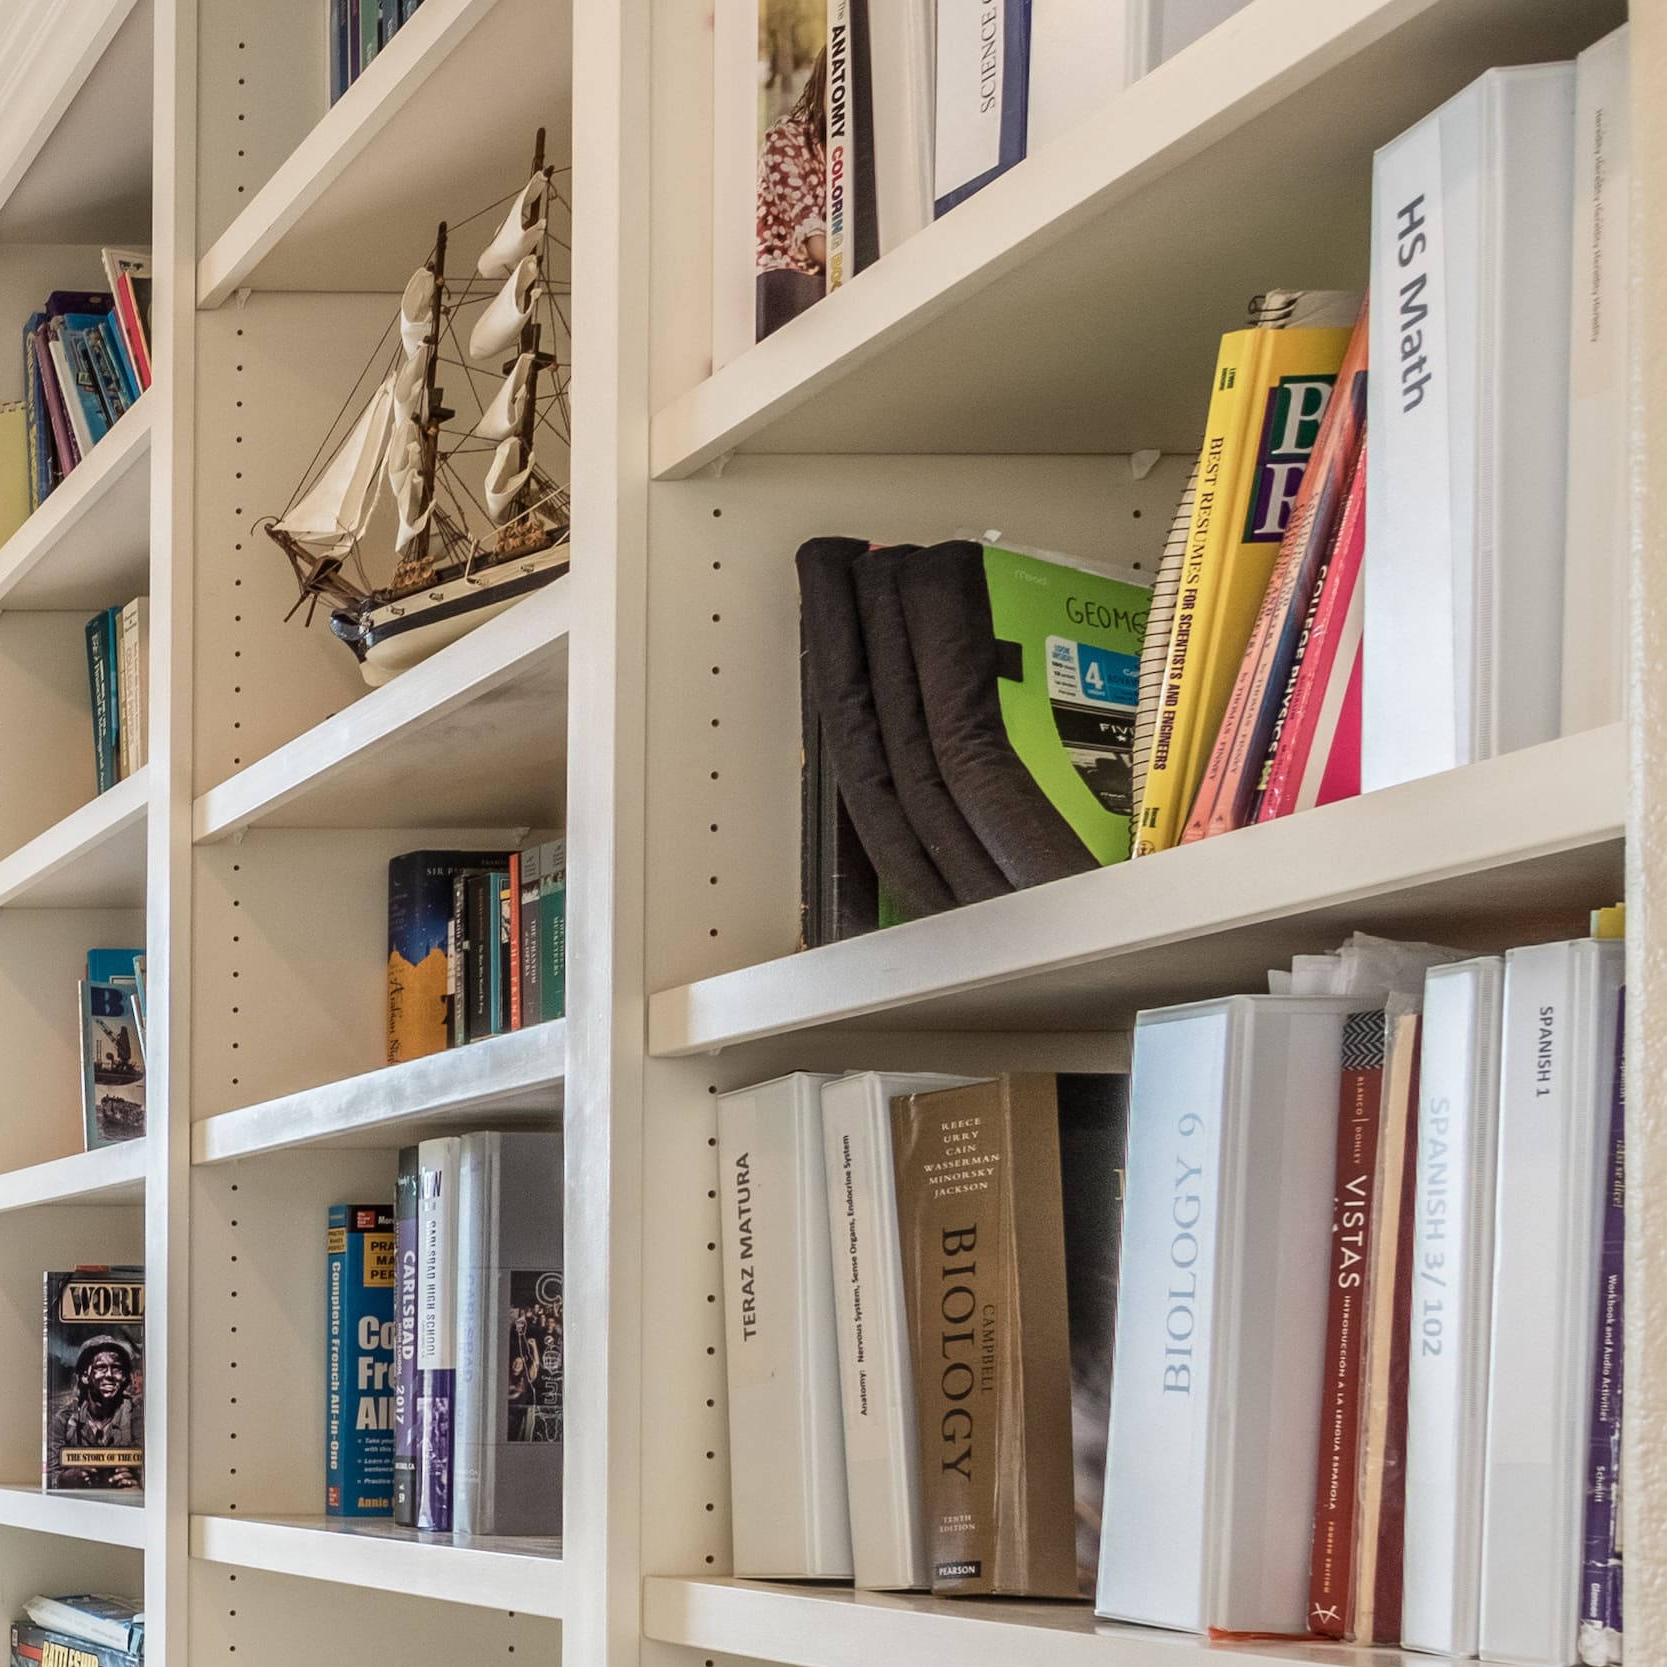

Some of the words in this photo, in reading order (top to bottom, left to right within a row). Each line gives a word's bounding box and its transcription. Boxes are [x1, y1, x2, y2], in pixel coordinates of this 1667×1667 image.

[831, 24, 846, 138] ANATOMY
[980, 7, 997, 114] SCIENCE
[830, 146, 844, 250] COLORING
[1397, 193, 1426, 268] HS
[1400, 272, 1432, 414] Math
[1204, 436, 1225, 488] BEST
[1187, 491, 1215, 587] RESUMES
[1178, 587, 1198, 612] FOR
[1167, 613, 1194, 679] SCIENTISTS
[1084, 661, 1104, 690] 4
[1162, 681, 1183, 707] AND
[1152, 709, 1178, 771] ENGINEERS
[1536, 1005, 1555, 1083] SPANISH
[1536, 1086, 1551, 1098] 1
[941, 1117, 982, 1131] REECE
[943, 1130, 980, 1144] URRY
[1178, 1112, 1205, 1136] 9
[840, 1134, 853, 1168] System
[923, 1153, 1000, 1172] WASSERMAN
[945, 1144, 977, 1156] CAIN
[1426, 1095, 1450, 1242] SPANISH
[842, 1170, 857, 1216] Endocrine
[929, 1167, 994, 1185] MINORSKY
[934, 1182, 988, 1199] JACKSON
[735, 1151, 756, 1261] MATURA
[425, 1220, 437, 1279] CARLSBAD
[845, 1217, 859, 1251] Organs,
[1338, 1174, 1368, 1289] VISTAS
[848, 1254, 861, 1283] Sense
[1163, 1154, 1203, 1397] BIOLOGY
[1421, 1252, 1447, 1288] 3/
[328, 1261, 341, 1334] Complete
[401, 1250, 415, 1359] CARLSBAD
[425, 1284, 436, 1309] HIGH
[742, 1265, 757, 1343] TERAZ
[850, 1285, 863, 1321] System,
[1604, 1274, 1618, 1324] Workbook
[424, 1314, 436, 1357] SCHOOL
[852, 1323, 866, 1362] Nervous
[981, 1303, 996, 1394] CAMPBELL
[1422, 1301, 1443, 1357] 102
[1602, 1327, 1614, 1344] and
[328, 1338, 341, 1388] French
[942, 1224, 978, 1482] BIOLOGY
[1600, 1347, 1613, 1374] Audio
[394, 1385, 405, 1424] 2017
[855, 1369, 870, 1416] Anatomy:
[1596, 1377, 1611, 1421] Activities
[328, 1393, 341, 1470] All-in-One
[66, 1453, 81, 1462] THE
[81, 1453, 105, 1462] STORY
[106, 1453, 116, 1462] OF
[117, 1453, 132, 1462] THE
[939, 1522, 976, 1533] EDITION
[938, 1565, 976, 1577] PEARSON
